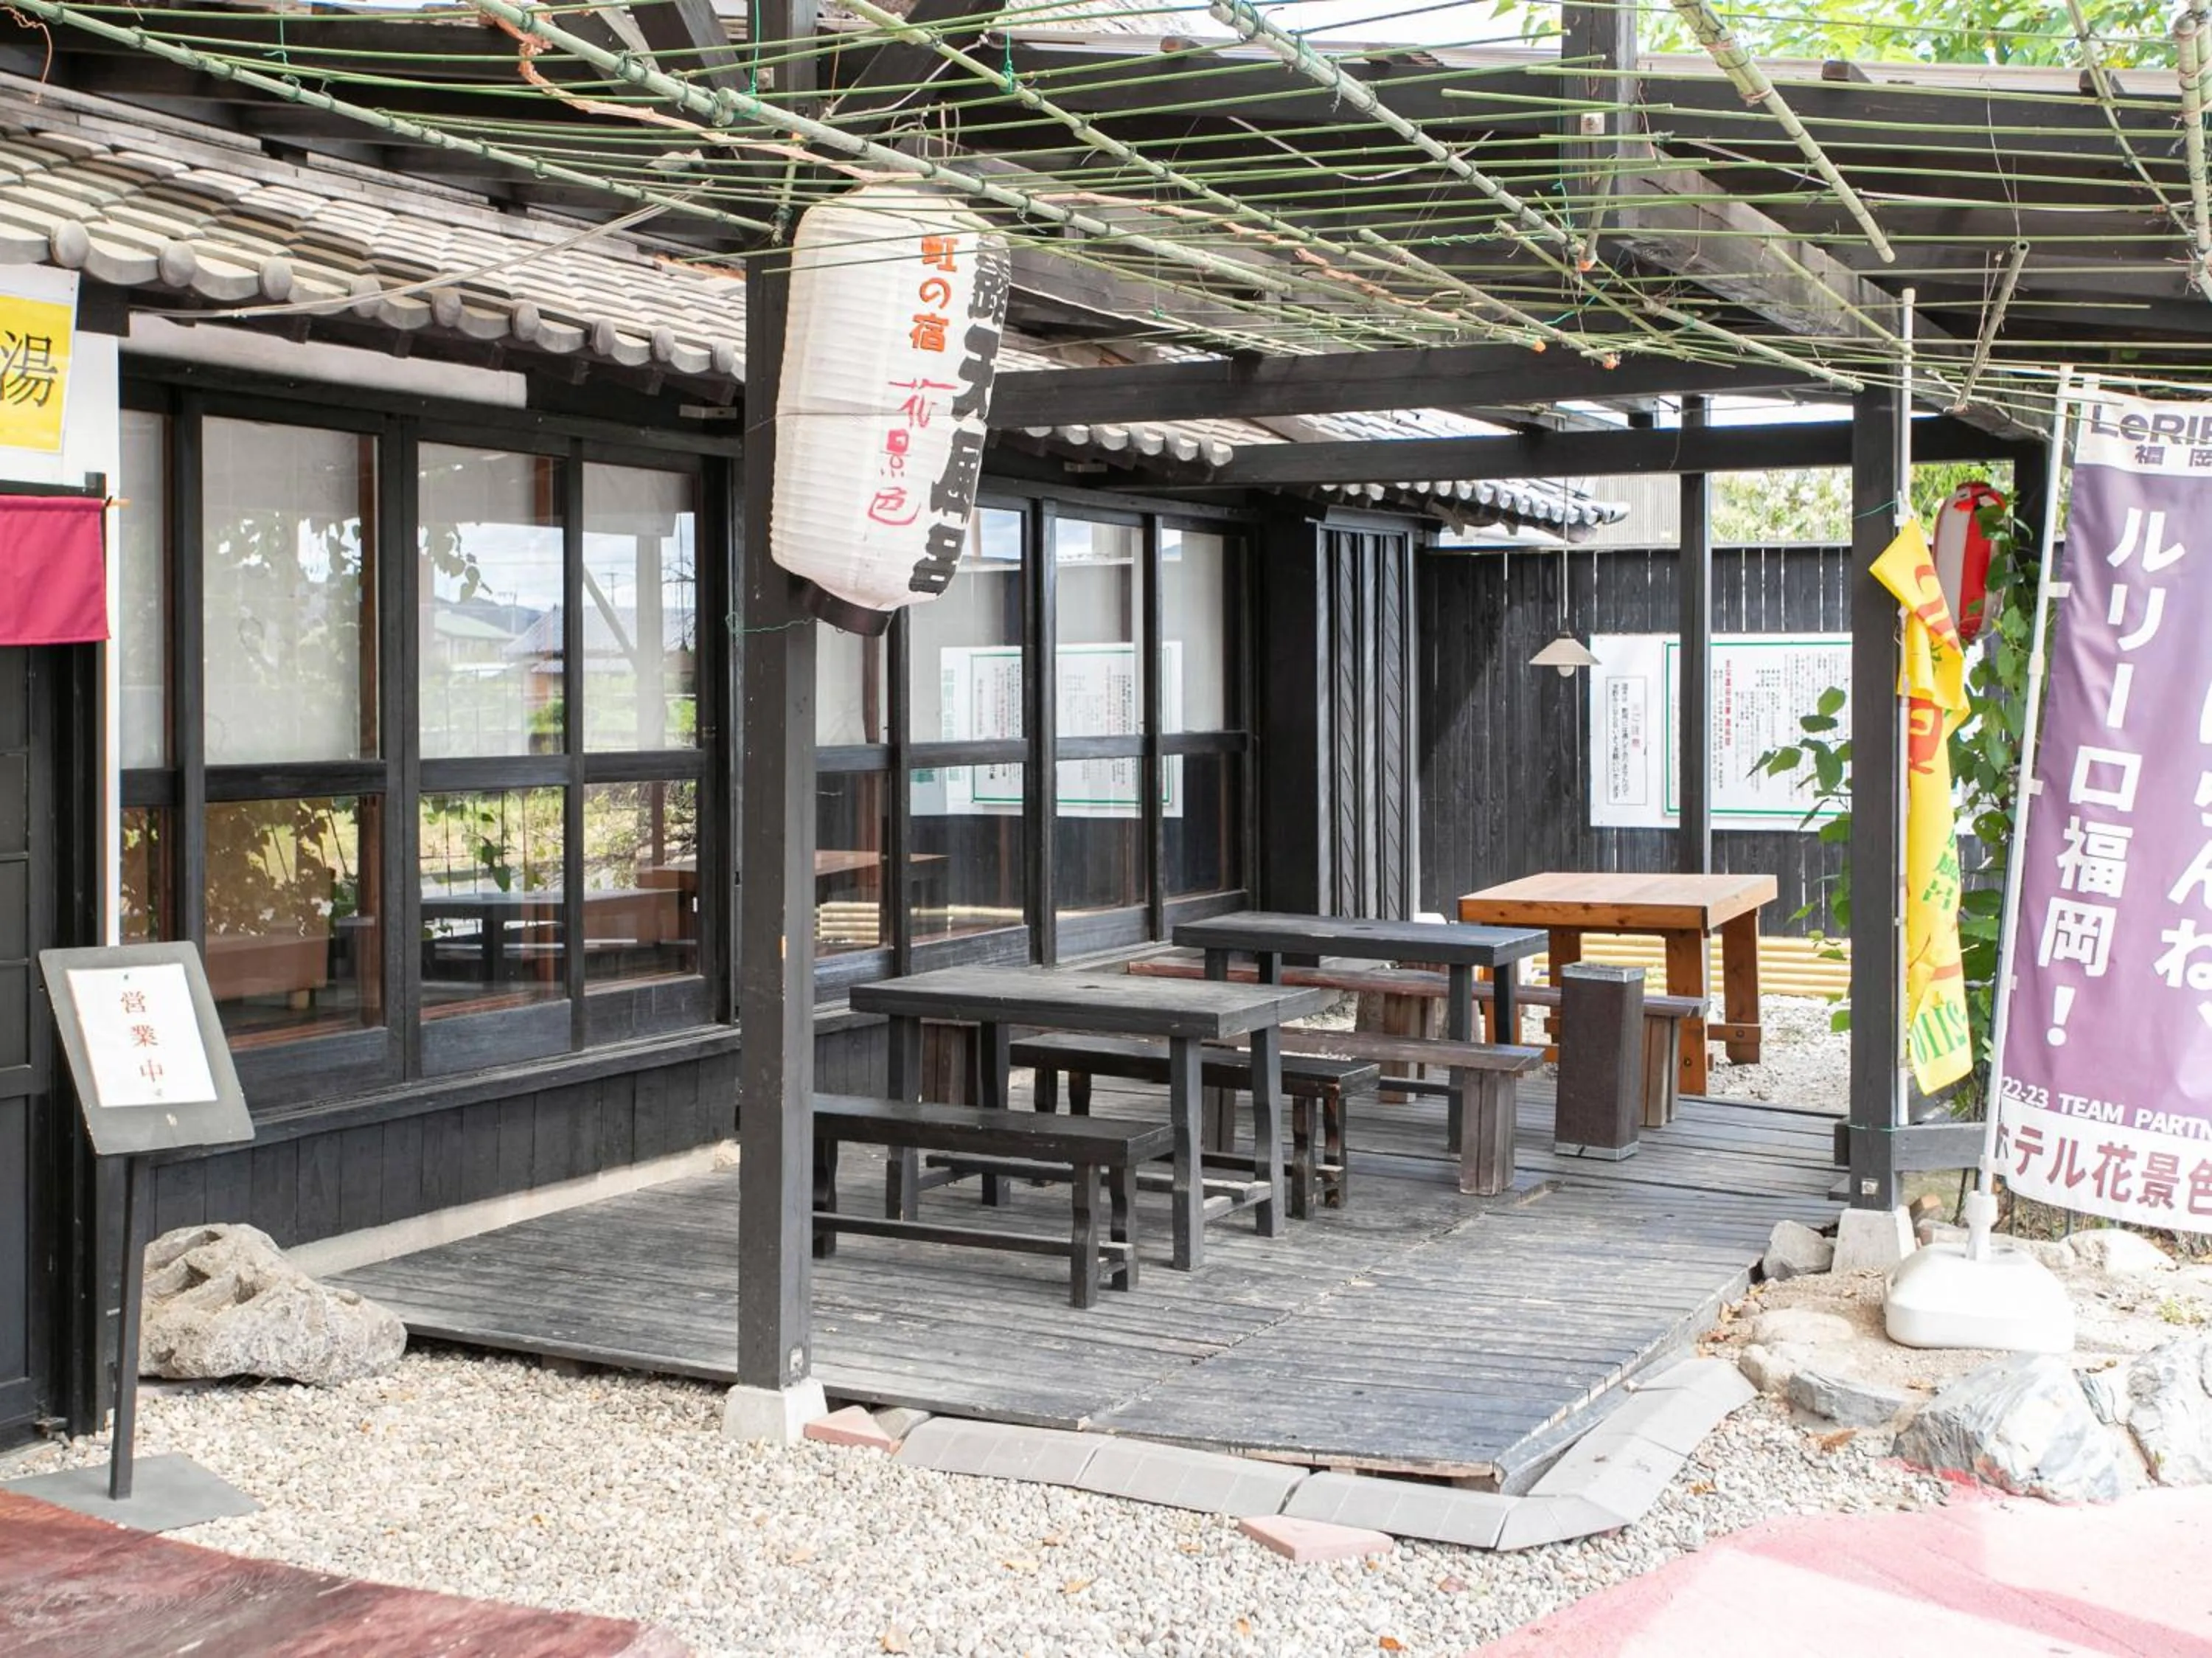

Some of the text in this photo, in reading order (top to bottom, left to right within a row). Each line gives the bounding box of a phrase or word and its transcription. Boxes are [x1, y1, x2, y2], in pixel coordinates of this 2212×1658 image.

[866, 378, 959, 526] 花景色
[120, 991, 164, 1083] 営業中
[2058, 1093, 2124, 1125] TEAM
